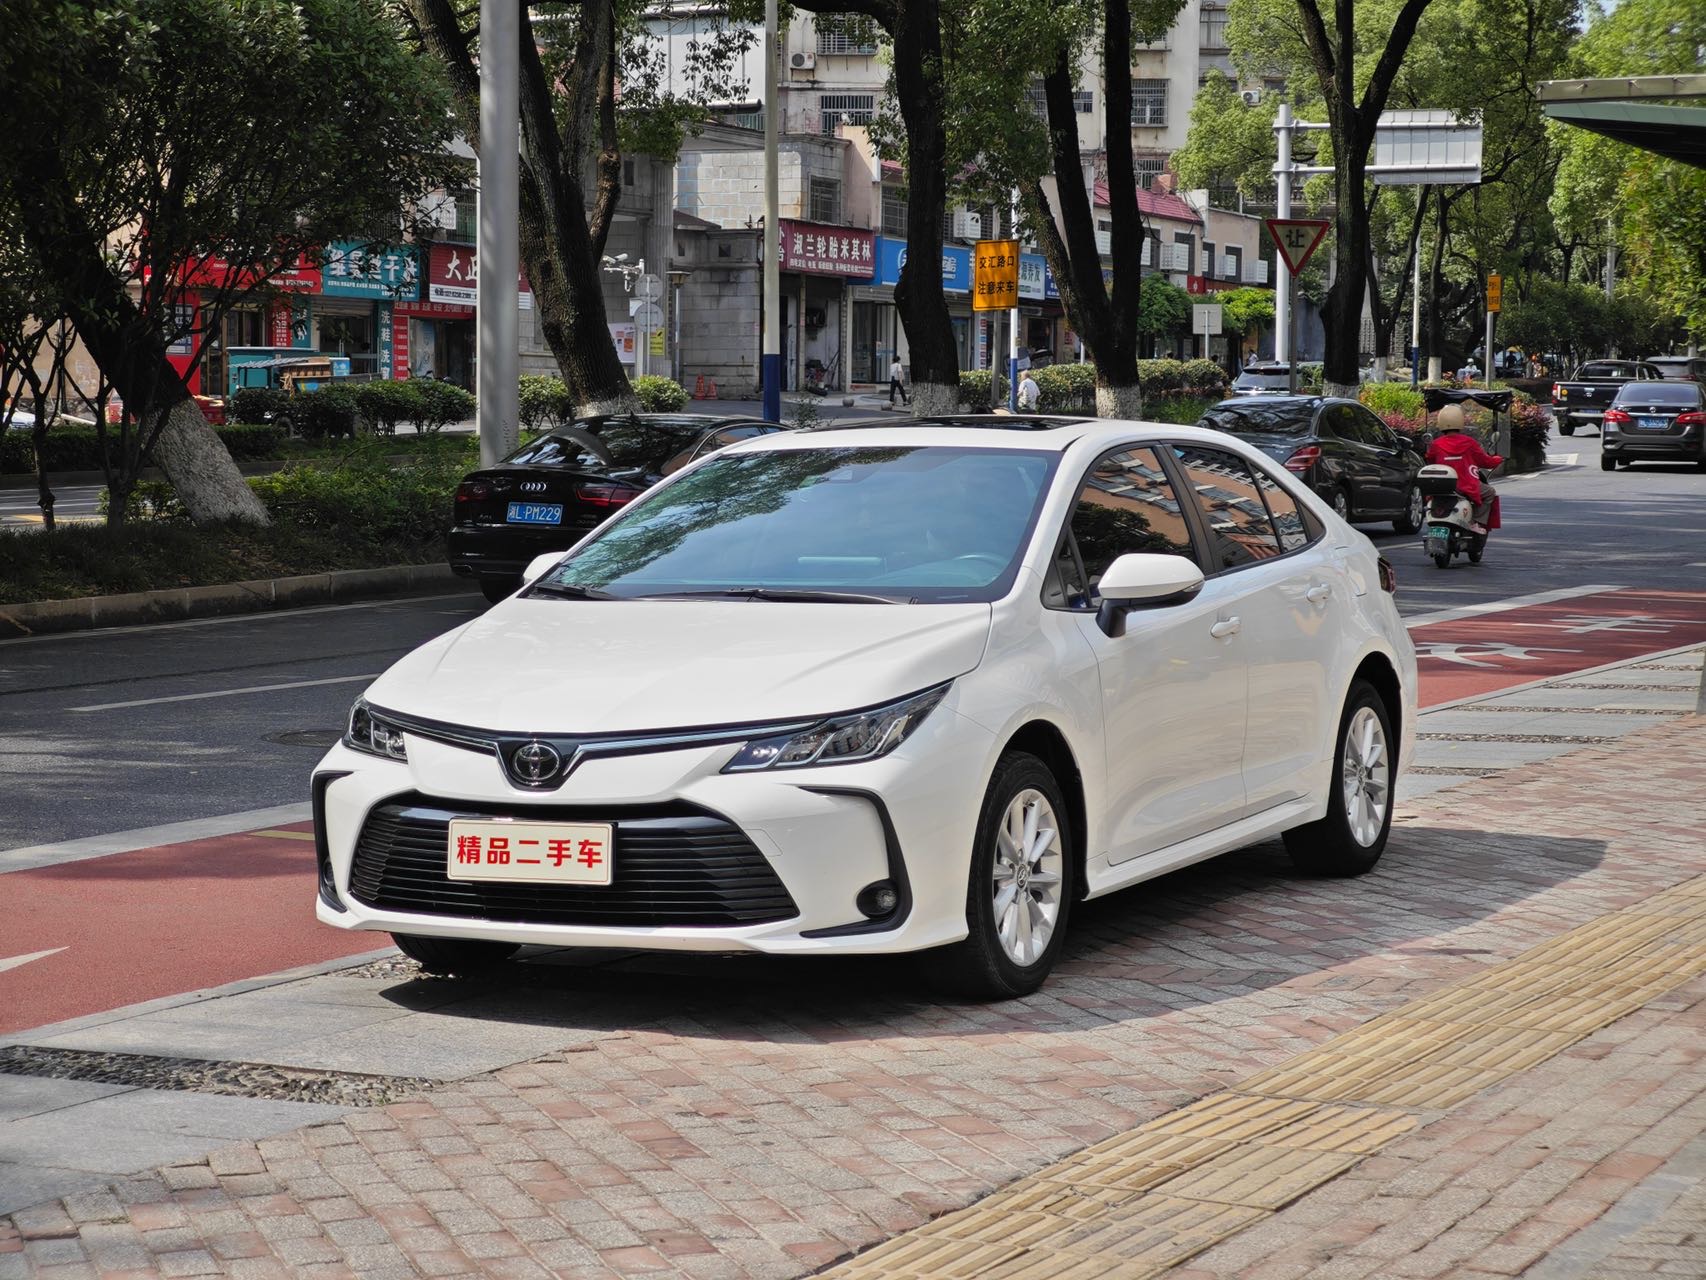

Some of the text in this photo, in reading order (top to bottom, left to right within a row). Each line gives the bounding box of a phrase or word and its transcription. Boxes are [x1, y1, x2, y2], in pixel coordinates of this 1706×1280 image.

[1285, 229, 1304, 248] 让
[979, 255, 1015, 269] 交汇路口
[977, 281, 1015, 295] 注意来车
[456, 835, 603, 869] 精品二手车
